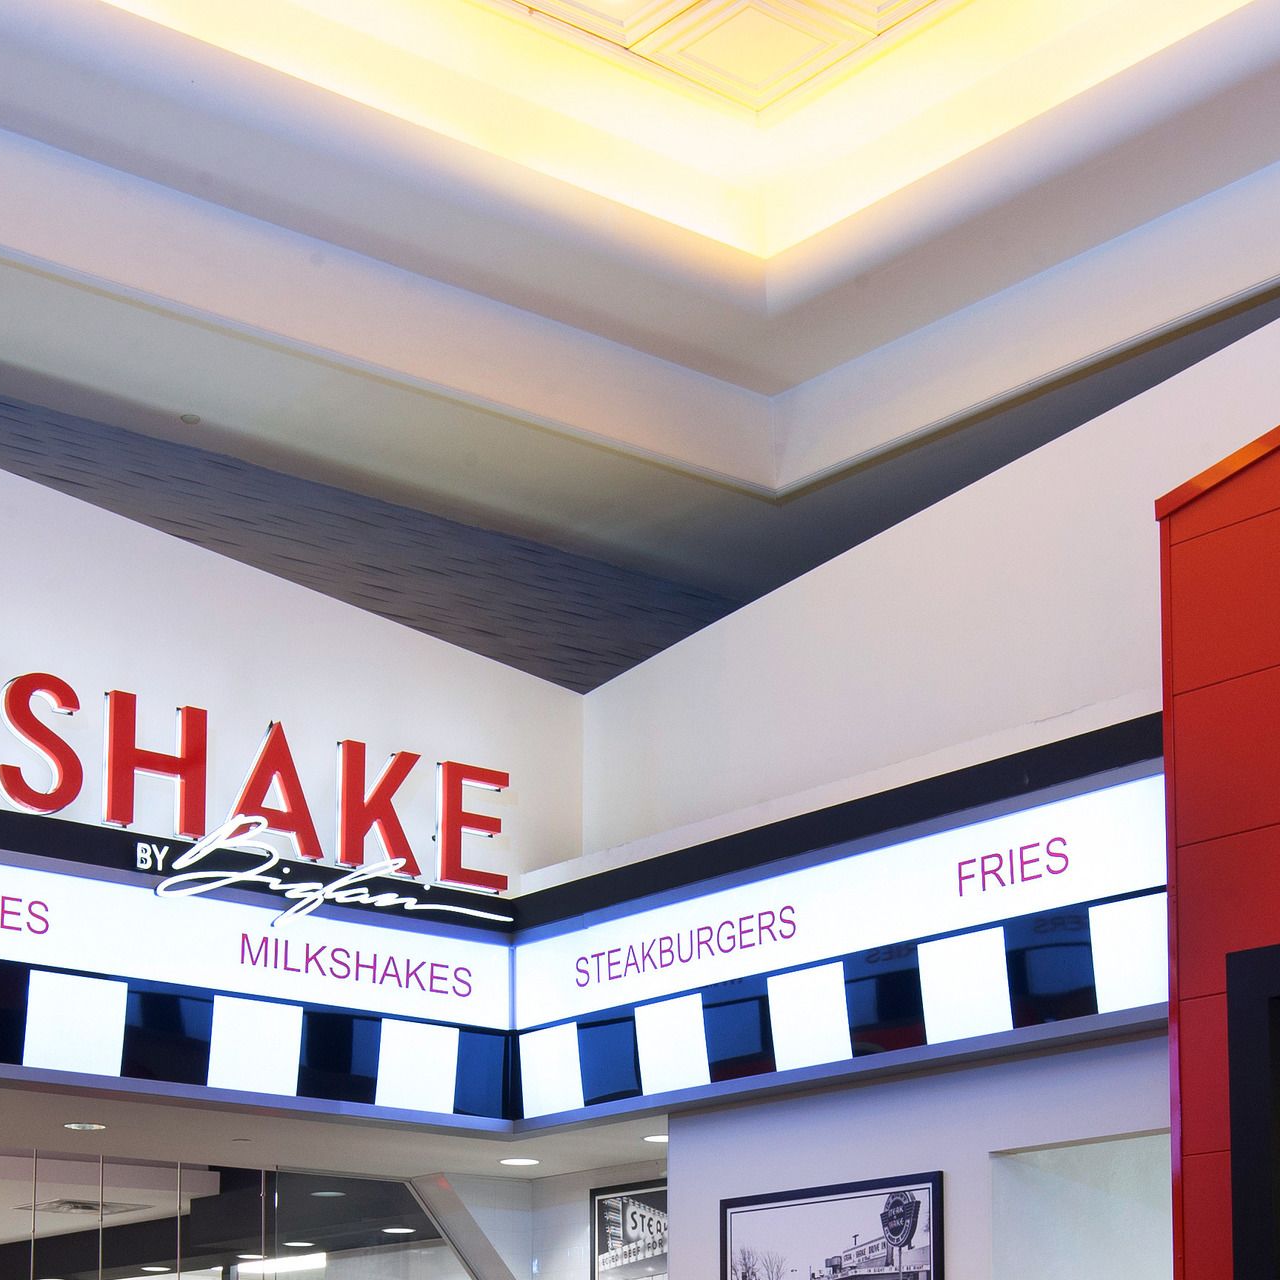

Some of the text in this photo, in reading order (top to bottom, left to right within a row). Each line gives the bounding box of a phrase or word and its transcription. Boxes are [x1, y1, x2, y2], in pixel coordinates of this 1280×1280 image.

[135, 842, 169, 872] BY
[957, 837, 1070, 897] FRIES
[239, 933, 472, 998] MILKSHAKES
[574, 905, 797, 988] STEAKBURGERS
[623, 1246, 641, 1259] BEEF
[647, 1239, 664, 1252] FOR
